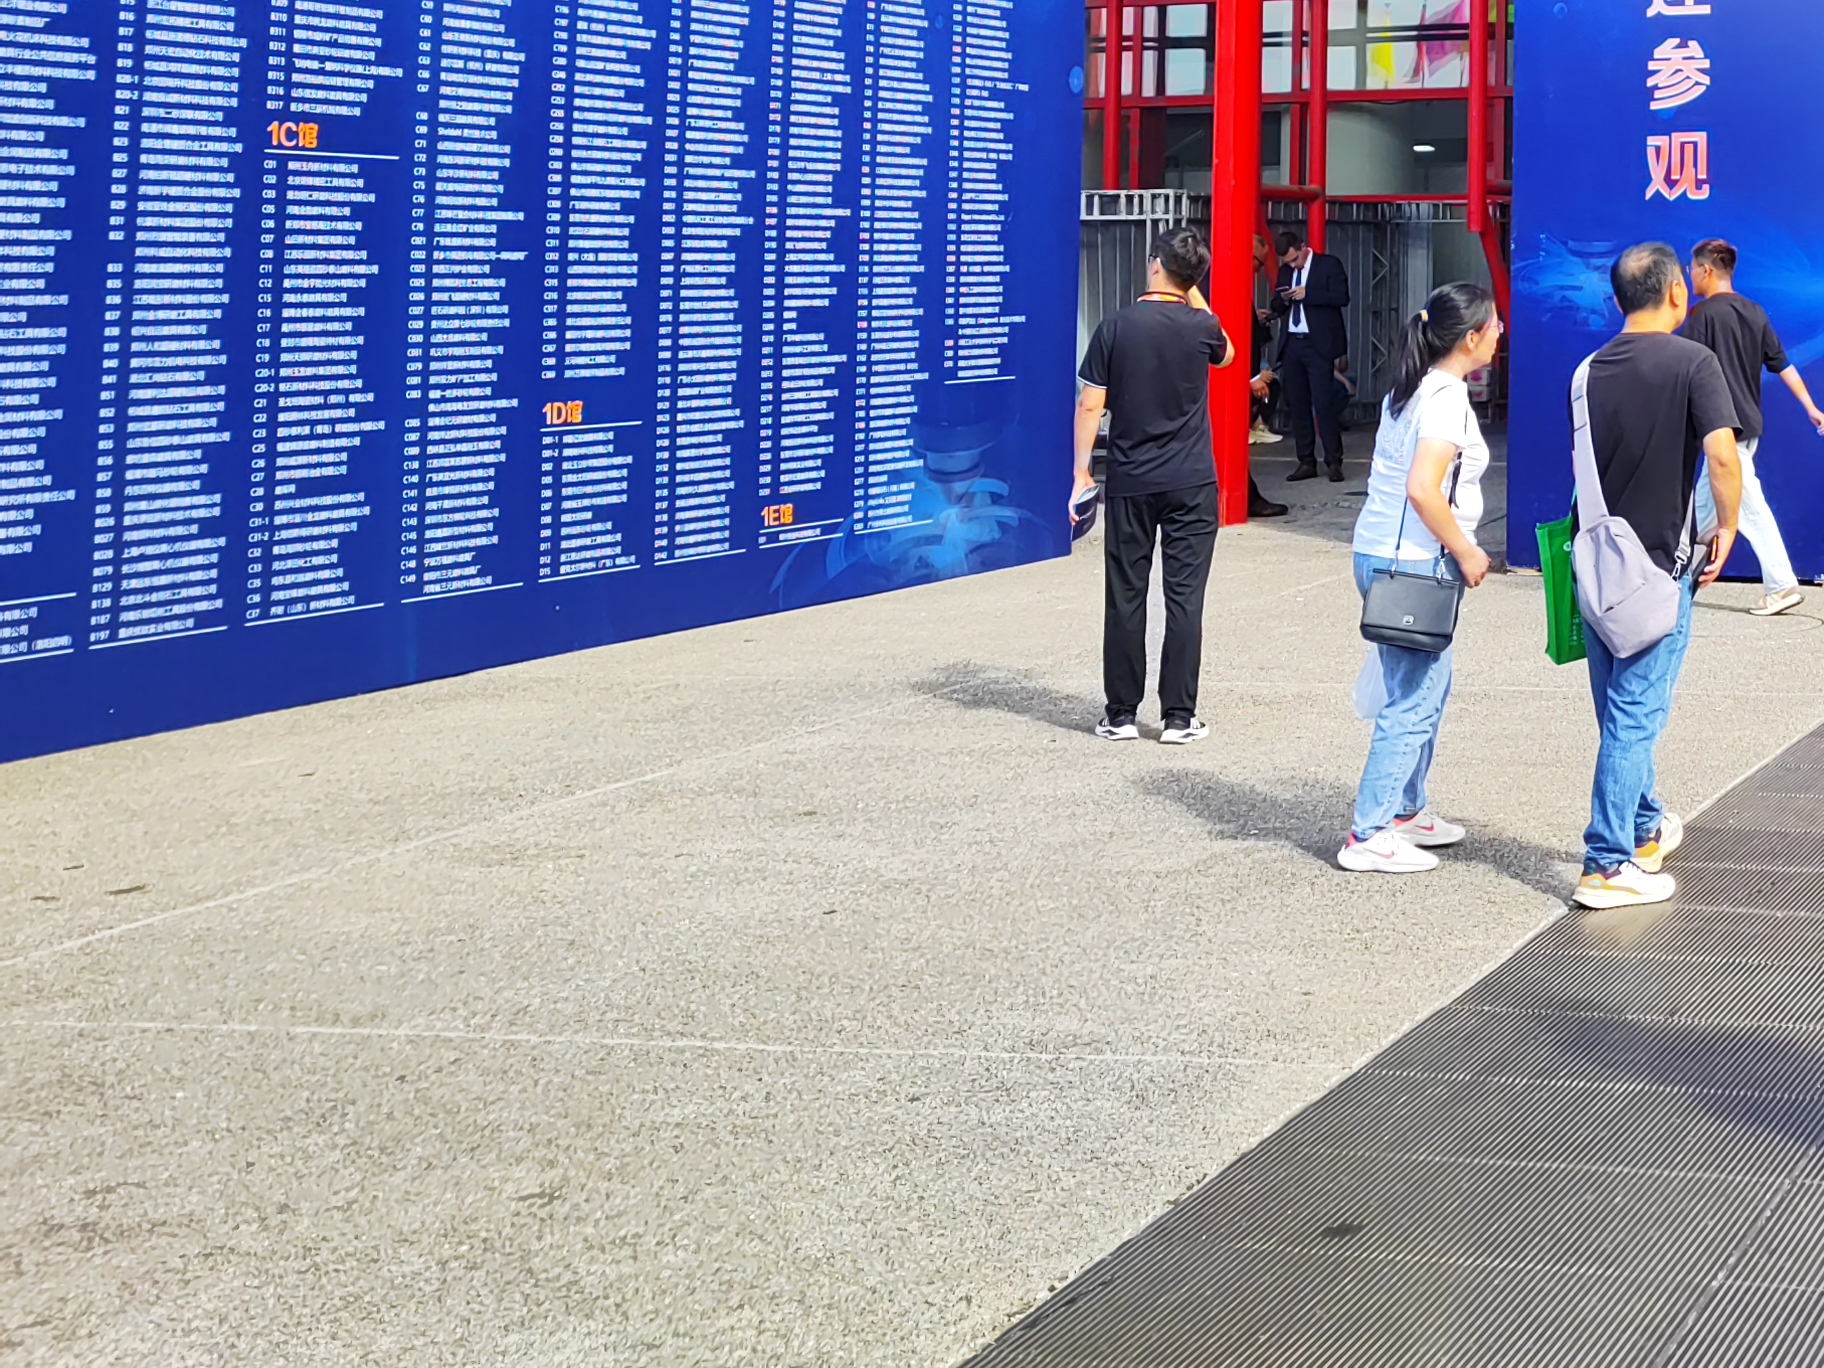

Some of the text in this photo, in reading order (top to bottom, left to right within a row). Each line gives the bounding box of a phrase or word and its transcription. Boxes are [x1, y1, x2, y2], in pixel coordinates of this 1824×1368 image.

[118, 10, 135, 21] B16
[118, 26, 135, 37] B17
[269, 26, 286, 37] B311
[268, 40, 287, 52] B312
[267, 121, 319, 149] 1C馆
[259, 264, 273, 274] C11
[258, 278, 273, 288] C12
[257, 293, 272, 303] C15
[257, 308, 272, 318] C16
[256, 323, 271, 333] C17
[542, 400, 584, 425] 1D馆
